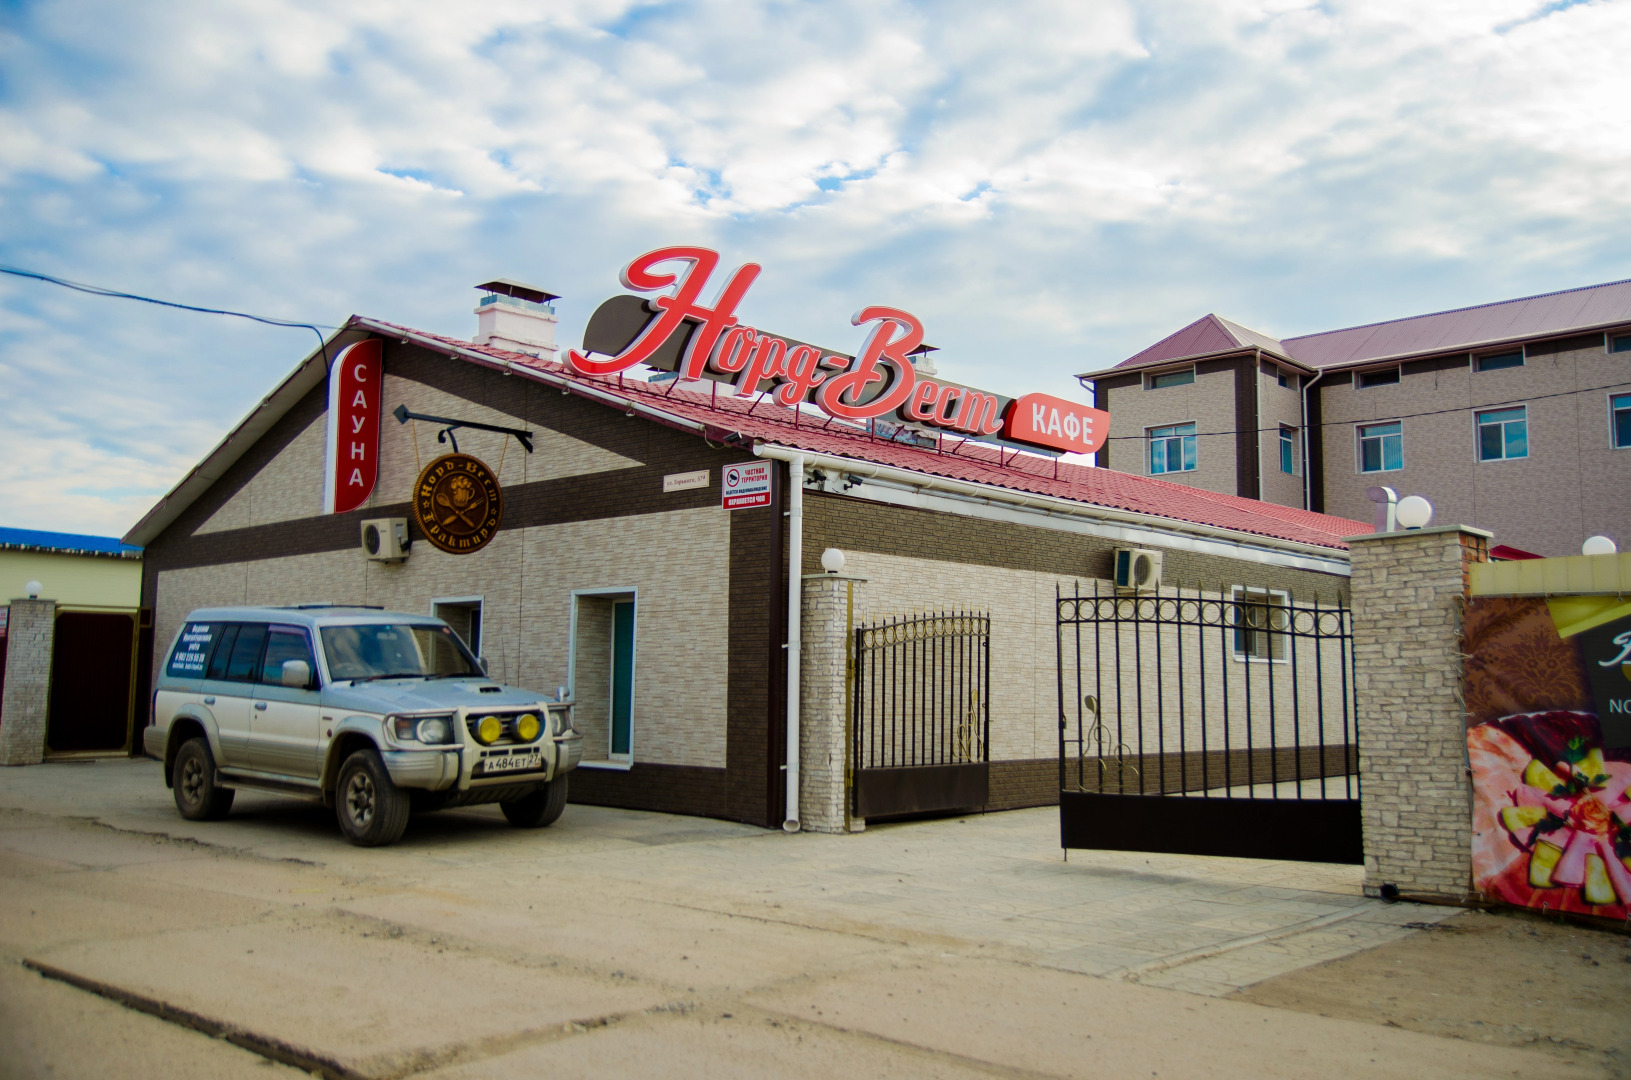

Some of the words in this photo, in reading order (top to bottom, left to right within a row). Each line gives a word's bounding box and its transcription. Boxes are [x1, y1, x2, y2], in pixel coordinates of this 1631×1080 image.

[562, 246, 1003, 437] Норд-Вест
[349, 364, 367, 487] САУНА
[1032, 402, 1093, 446] КАФЕ
[421, 461, 497, 502] Норд-Вест
[741, 474, 768, 484] ТЕРРИТОРИЯ
[744, 467, 765, 476] ЧАСТНАЯ
